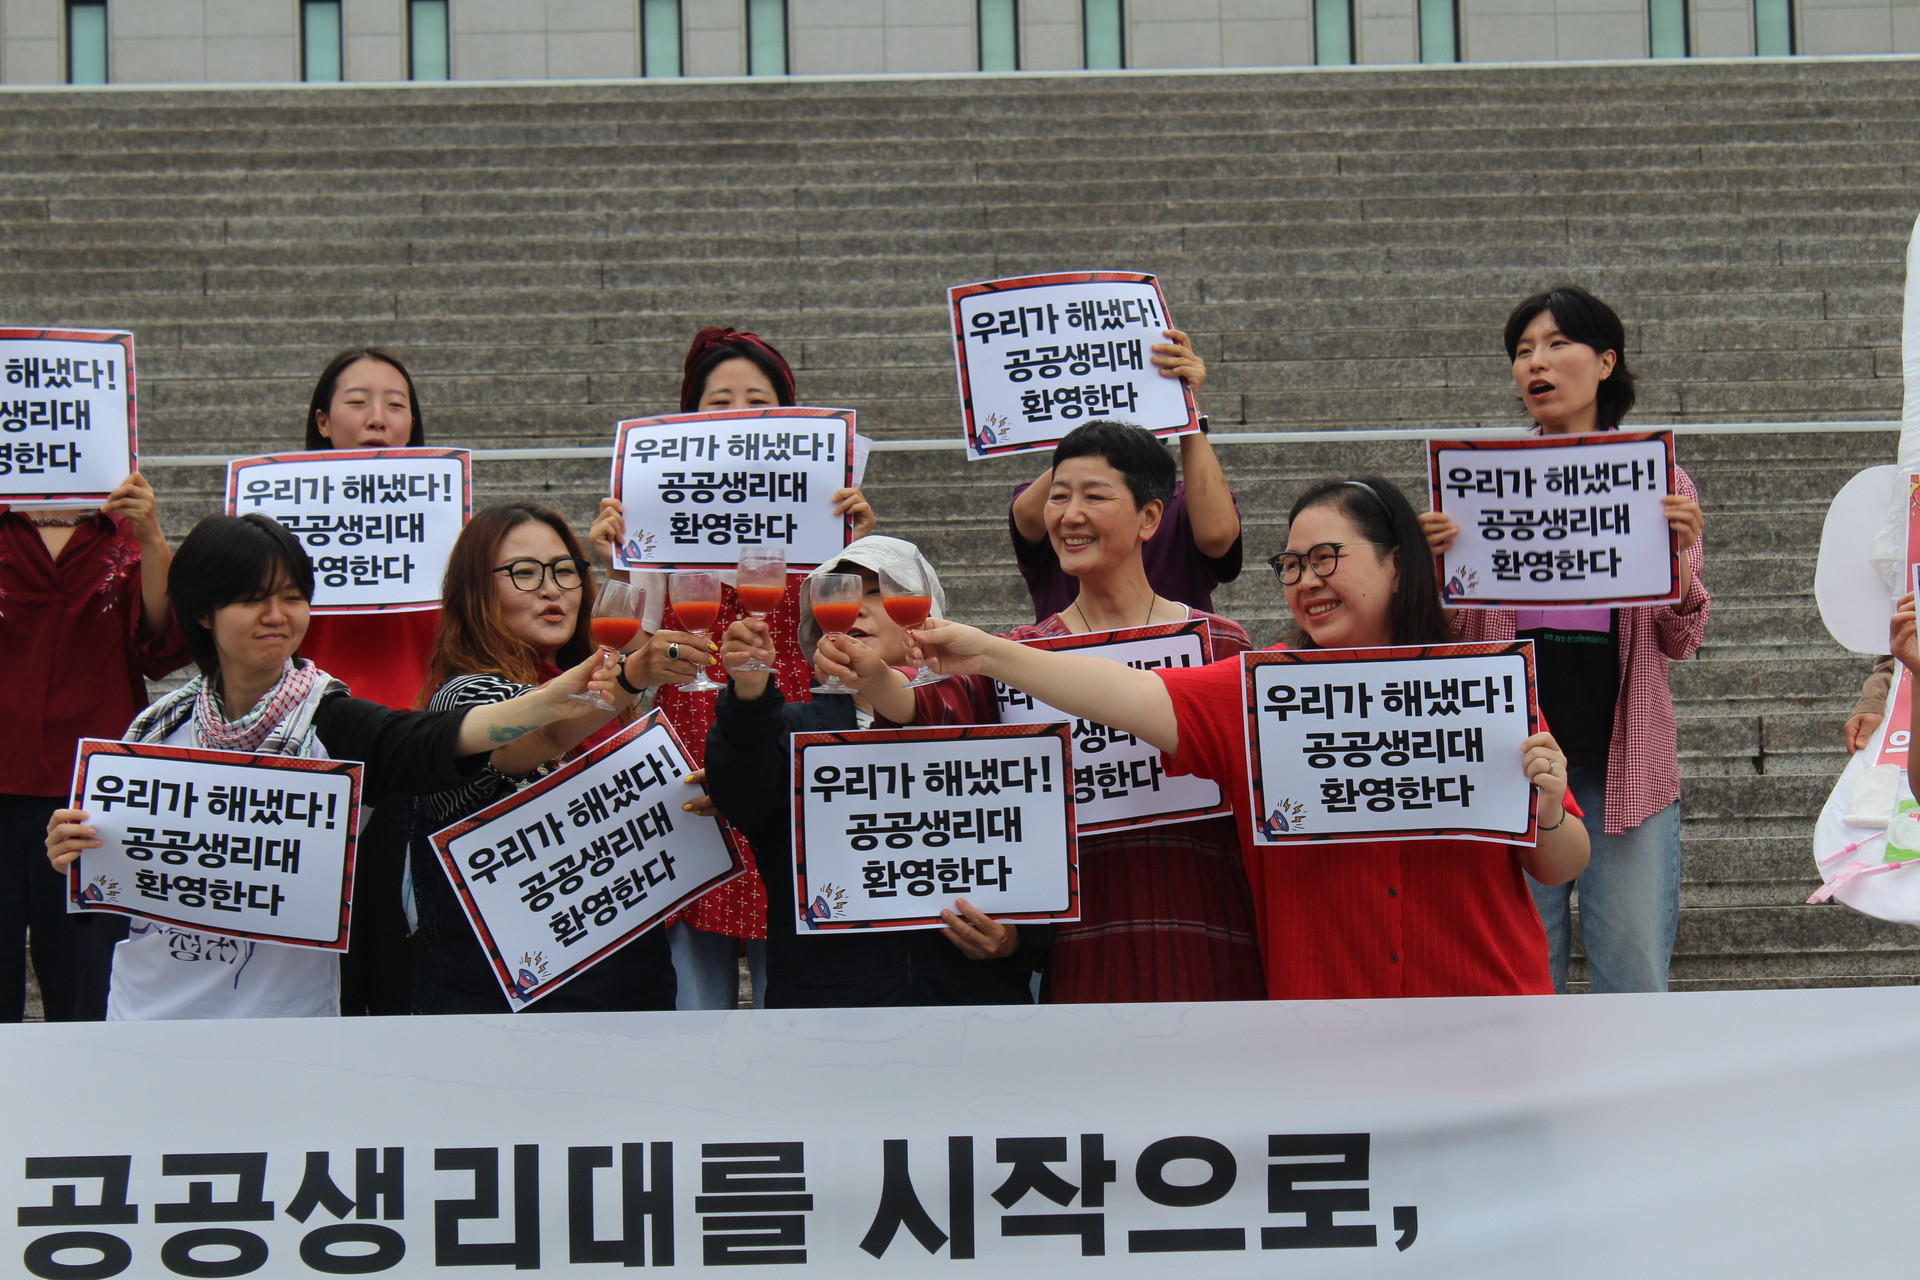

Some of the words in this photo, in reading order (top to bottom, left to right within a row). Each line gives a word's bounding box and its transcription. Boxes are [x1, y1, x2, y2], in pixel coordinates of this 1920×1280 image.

[969, 303, 1059, 344] 우리가
[1065, 298, 1161, 333] 해냈다!
[4, 357, 116, 390] 해냈다!
[1003, 339, 1143, 382] 공공생리대
[1020, 381, 1139, 422] 환영한다
[630, 434, 720, 463] 우리가
[727, 432, 836, 462] 해냈다!
[242, 475, 335, 506] 우리가
[341, 473, 452, 504] 해냈다!
[657, 471, 808, 504] 공공생리대
[1445, 466, 1536, 499] 우리가
[1543, 458, 1657, 496] 해냈다!
[276, 512, 425, 547] 공공생리대
[669, 511, 798, 545] 환영한다
[1477, 504, 1631, 541] 공공생리대
[310, 553, 416, 588] 영한다
[1491, 547, 1622, 582] 환영한다
[1544, 633, 1554, 641] we
[1555, 634, 1566, 643] are
[1263, 682, 1374, 722] 우리가
[1380, 675, 1516, 717] 해냈다!
[1302, 727, 1485, 769] 공공생리대
[809, 762, 915, 803] 우리가
[922, 755, 1052, 797] 해냈다!
[1074, 755, 1163, 804] 영한다
[1320, 774, 1475, 813] 환영한다
[90, 774, 199, 819] 우리가
[206, 784, 338, 830] 해냈다!
[468, 812, 565, 885] 우리가
[566, 743, 683, 828] 해냈다!
[845, 806, 1023, 851] 공공생리대
[120, 825, 302, 875] 공공생리대
[517, 800, 675, 913] 공공생리대
[134, 868, 286, 917] 환영한다
[861, 855, 1013, 898] 환영한다
[548, 849, 677, 948] 환영한다
[168, 929, 239, 965] 정치
[17, 1140, 814, 1280] 공공생리대를
[858, 1132, 1420, 1258] 시작으로,
